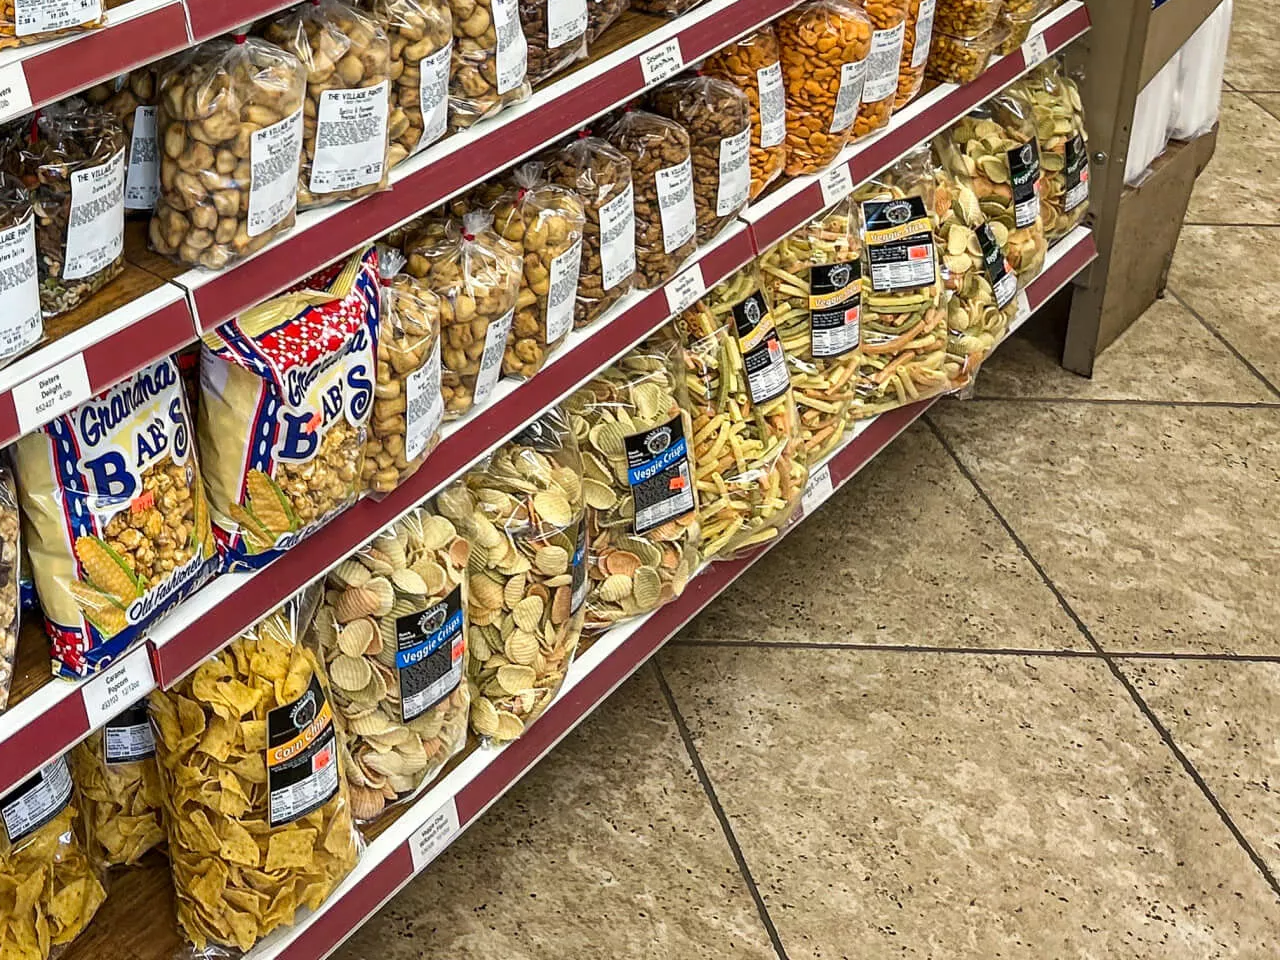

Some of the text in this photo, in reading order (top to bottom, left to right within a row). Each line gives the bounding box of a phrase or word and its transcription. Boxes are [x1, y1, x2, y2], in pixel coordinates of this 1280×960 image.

[39, 374, 59, 389] Dieters
[41, 383, 62, 399] Delight
[80, 361, 176, 447] Grandma
[634, 444, 683, 480] Veggie Crisps
[130, 546, 202, 620] Old Fashioned
[403, 616, 459, 663] Veggie Crisps
[106, 666, 126, 684] Caramel
[108, 677, 128, 694] Popcorn
[274, 712, 326, 760] Corn Chips
